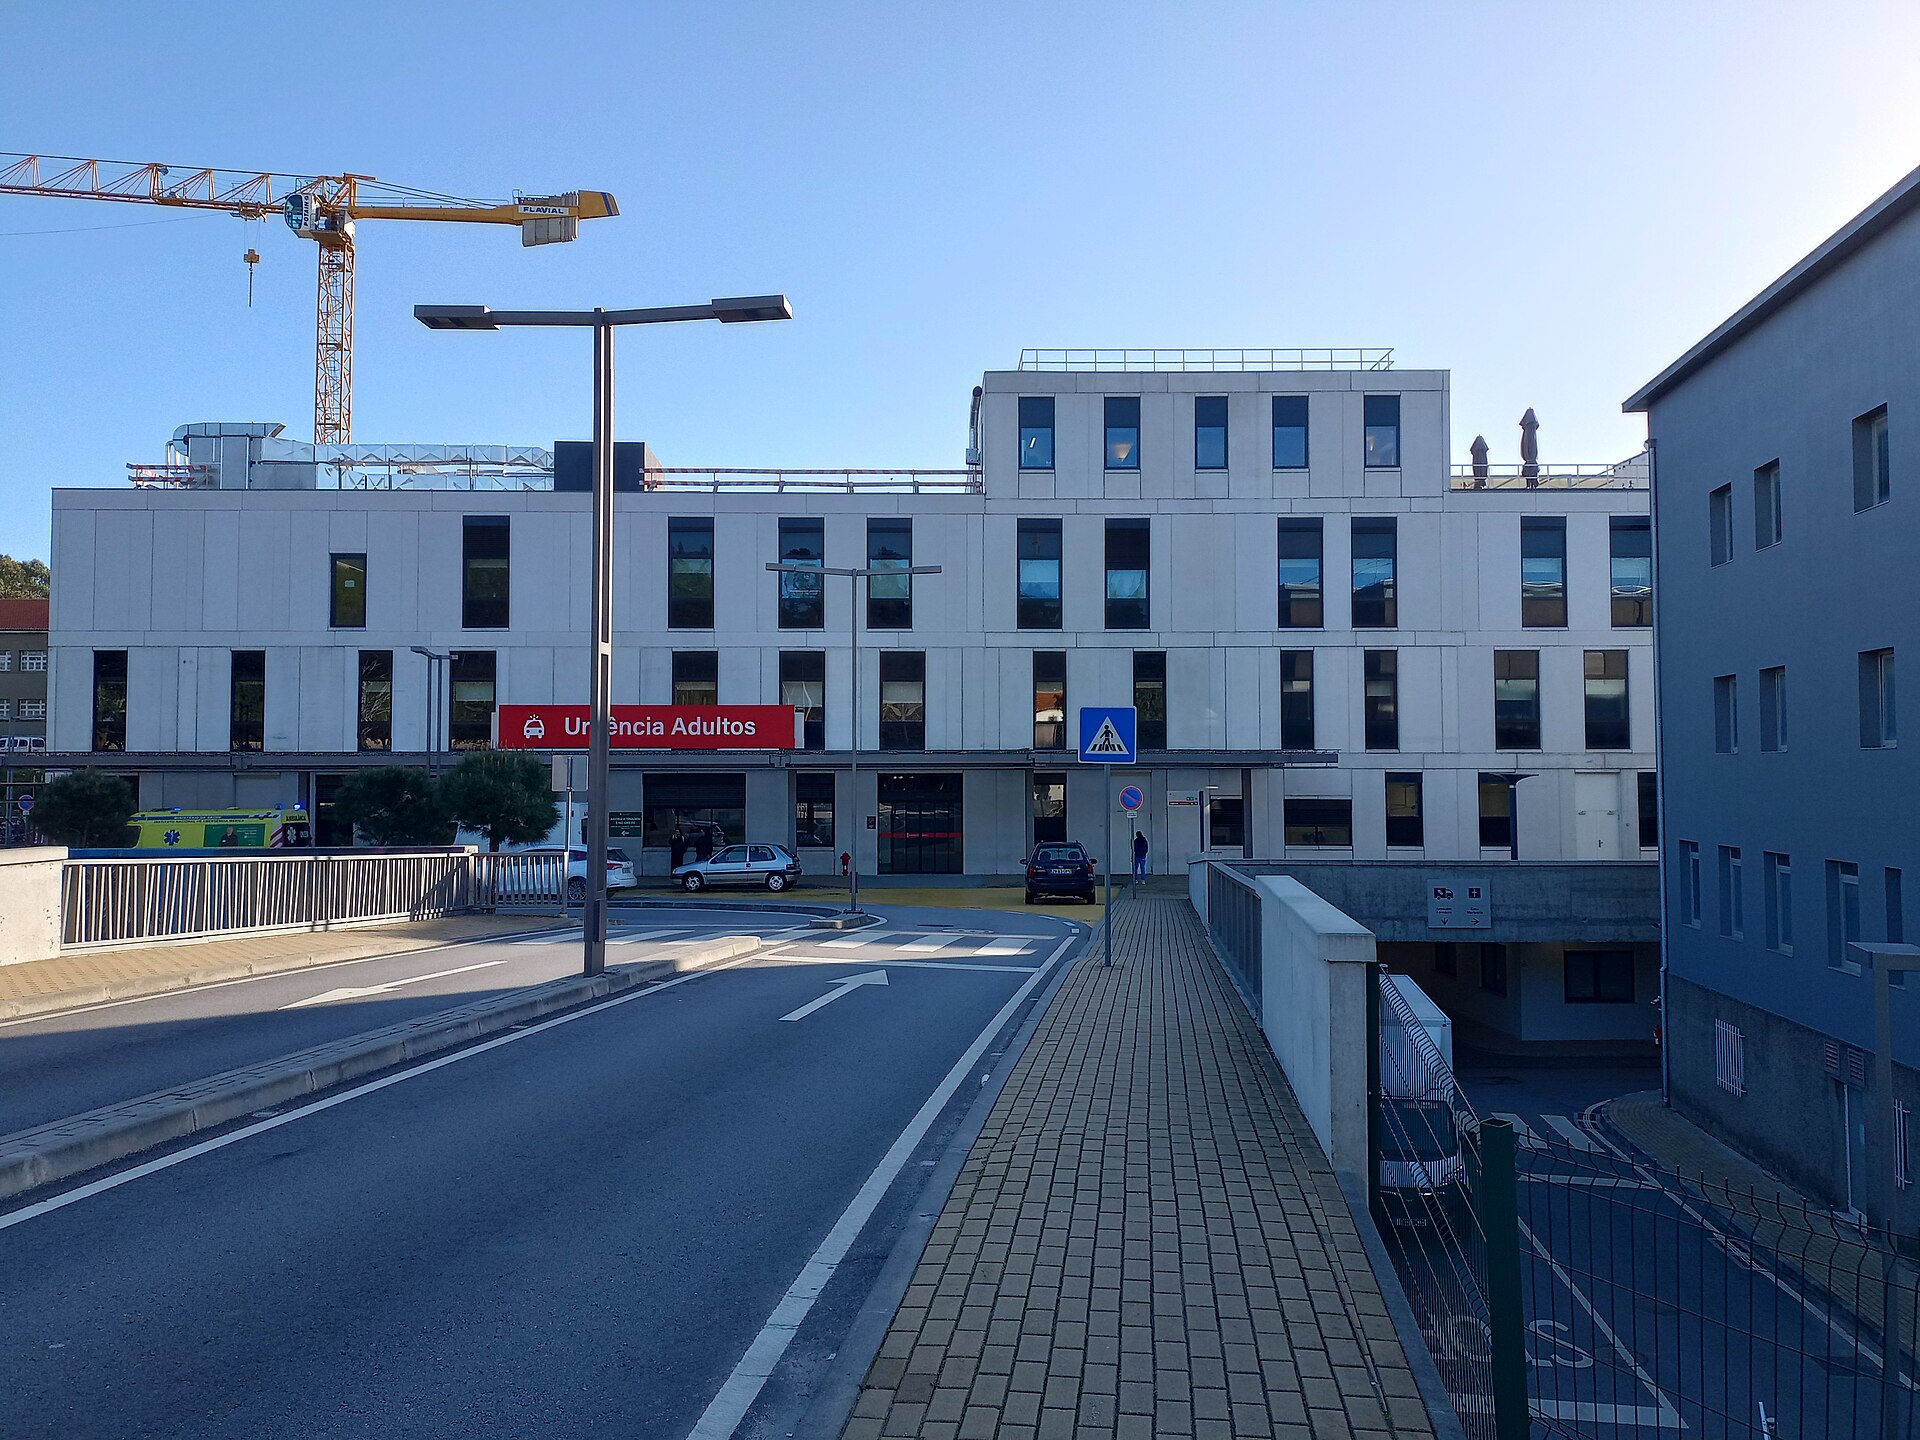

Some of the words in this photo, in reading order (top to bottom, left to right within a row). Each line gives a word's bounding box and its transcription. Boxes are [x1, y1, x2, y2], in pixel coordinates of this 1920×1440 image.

[523, 206, 564, 214] FLAVIAL
[564, 716, 664, 736] Urência
[671, 716, 756, 736] Adultos
